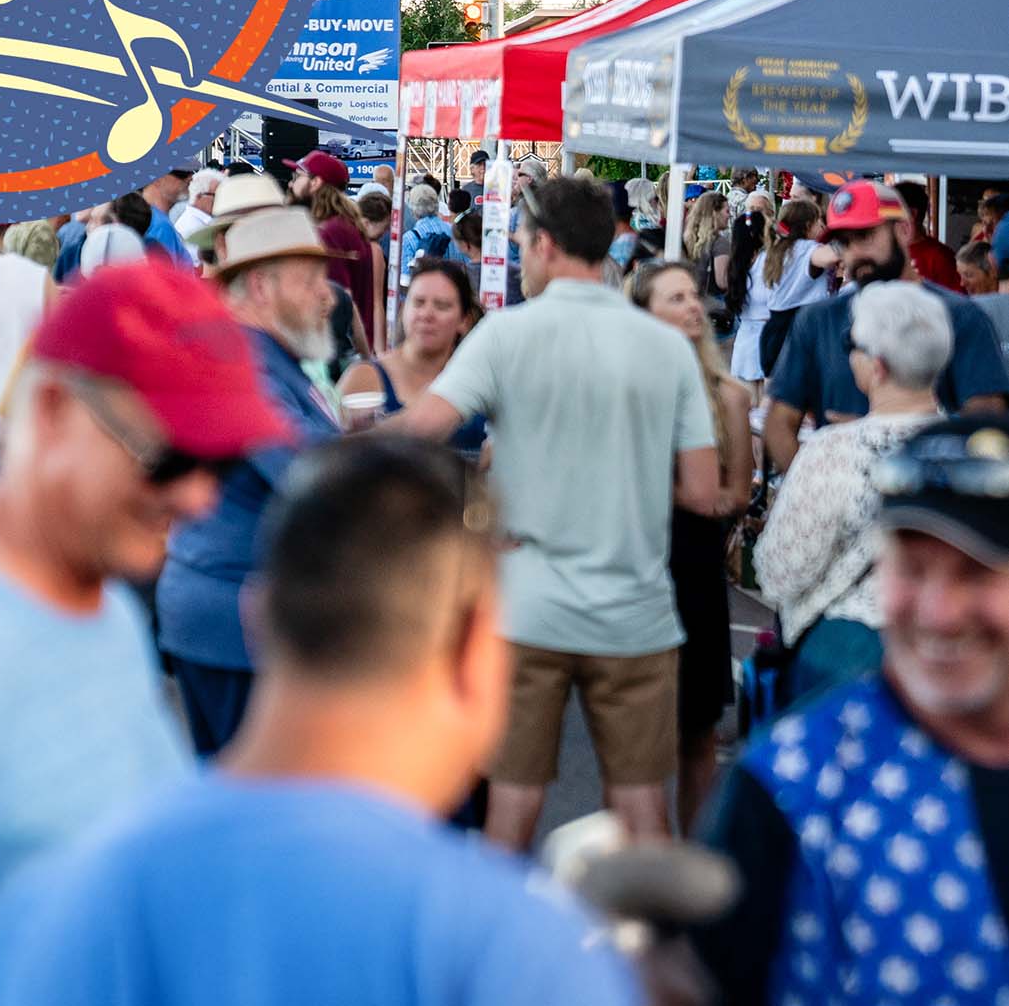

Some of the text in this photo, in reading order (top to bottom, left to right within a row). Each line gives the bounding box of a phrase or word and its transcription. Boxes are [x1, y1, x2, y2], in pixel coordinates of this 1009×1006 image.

[302, 56, 355, 71] United
[266, 83, 389, 94] ential & Commercial
[319, 100, 389, 109] orage Logistics
